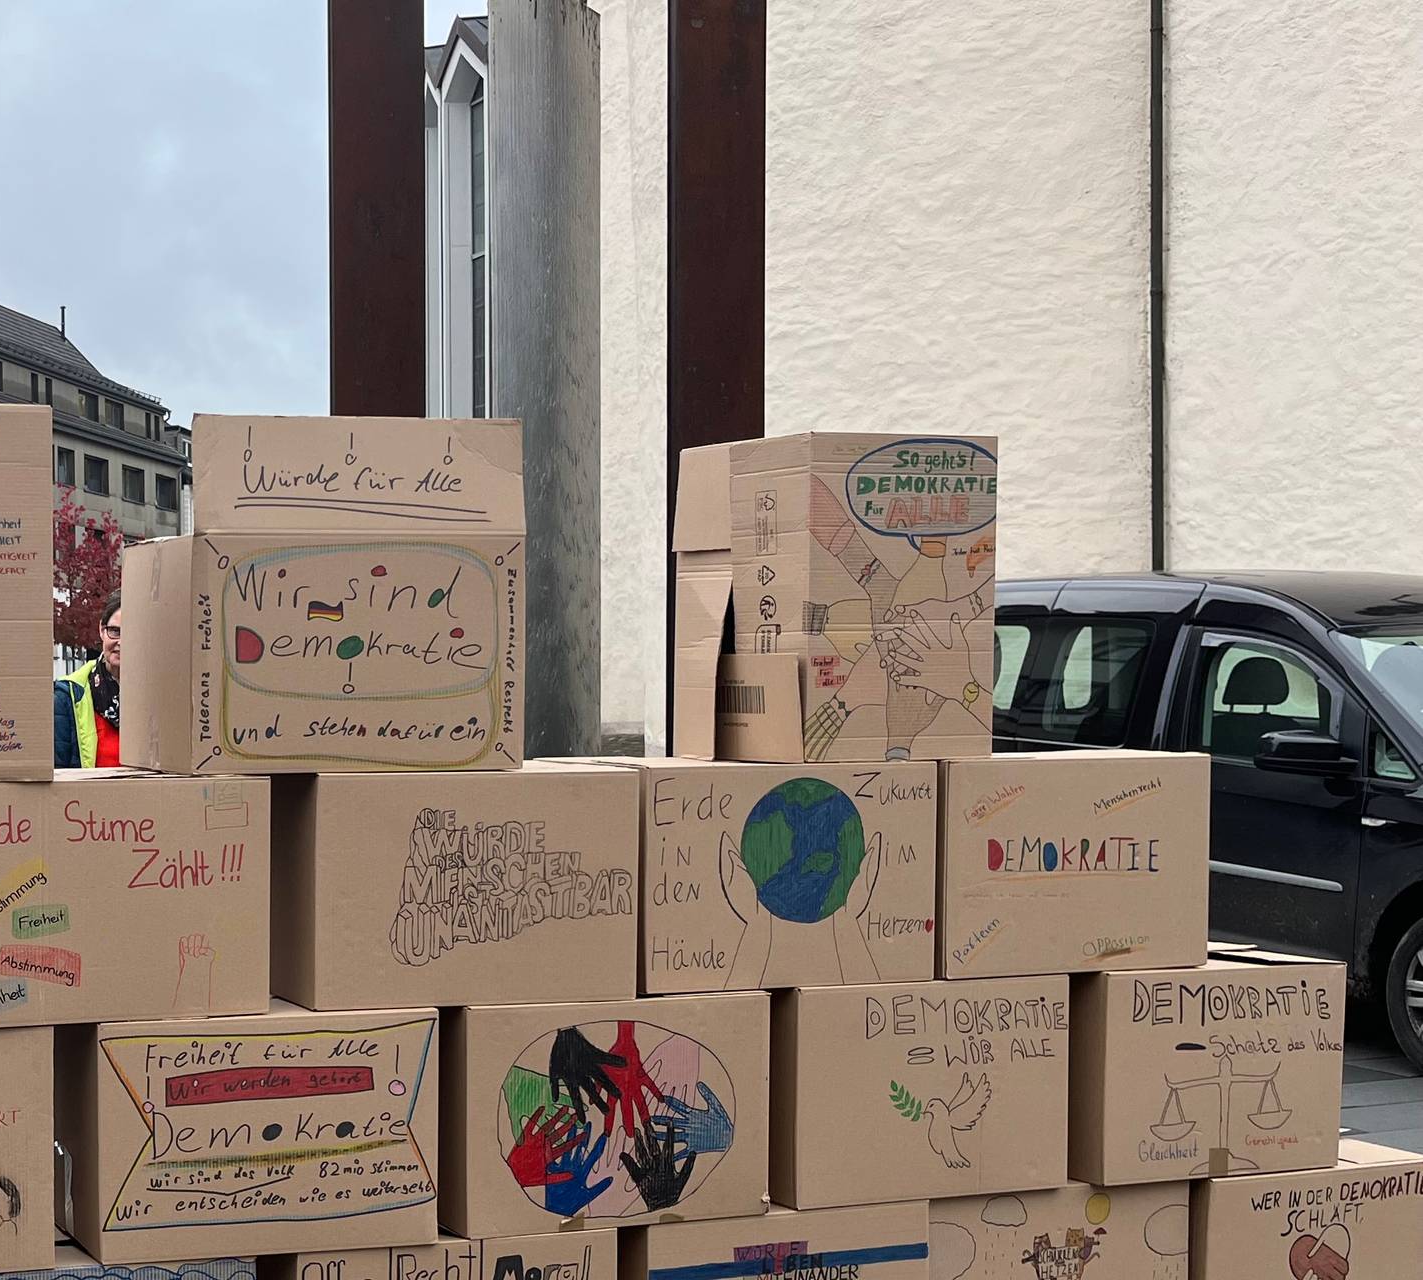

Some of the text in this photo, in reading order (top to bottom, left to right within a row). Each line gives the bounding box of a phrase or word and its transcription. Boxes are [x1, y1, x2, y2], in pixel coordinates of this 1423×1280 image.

[243, 464, 463, 493] Würde für Alle
[857, 475, 997, 495] DEMOKRATIE
[885, 494, 969, 528] ALLE
[233, 564, 462, 619] Wir sind
[199, 593, 211, 651] Freiheit
[235, 625, 488, 671] Demokratie
[503, 680, 515, 734] Respekt
[232, 714, 487, 744] und stehen dafür ein
[653, 777, 733, 827] Erde
[1093, 777, 1162, 815] Menschenrecht
[64, 800, 156, 843] Stime
[417, 808, 456, 831] DIE
[412, 821, 545, 868] WÜRDE
[987, 835, 1159, 872] DEMOKRATIE
[402, 852, 581, 904] MENSCHEN
[432, 851, 465, 873] DES
[18, 910, 65, 930] Freiheit
[389, 869, 632, 967] UNANTASTBAR
[867, 911, 925, 940] Herzen
[952, 918, 1001, 964] Parteien
[0, 954, 75, 987] Abstimmung
[866, 995, 1068, 1040] DEMOKRATIE
[1133, 979, 1330, 1027] DEMOKRATIE
[145, 1039, 379, 1072] Freiheit für Alle
[1011, 1039, 1055, 1063] ALLE
[1287, 1039, 1305, 1052] des
[168, 1080, 209, 1101] Wir
[223, 1070, 291, 1092] werden
[152, 1110, 408, 1160] Demokratie
[1138, 1140, 1199, 1162] Gleichheit
[188, 1171, 223, 1186] sind
[234, 1167, 255, 1180] das
[175, 1190, 287, 1211] entscheiden
[298, 1187, 327, 1204] wie
[335, 1189, 351, 1200] es
[362, 1180, 432, 1200] weitergeht
[1251, 1191, 1281, 1212] WER
[1289, 1190, 1301, 1208] IN
[1306, 1187, 1333, 1205] DER
